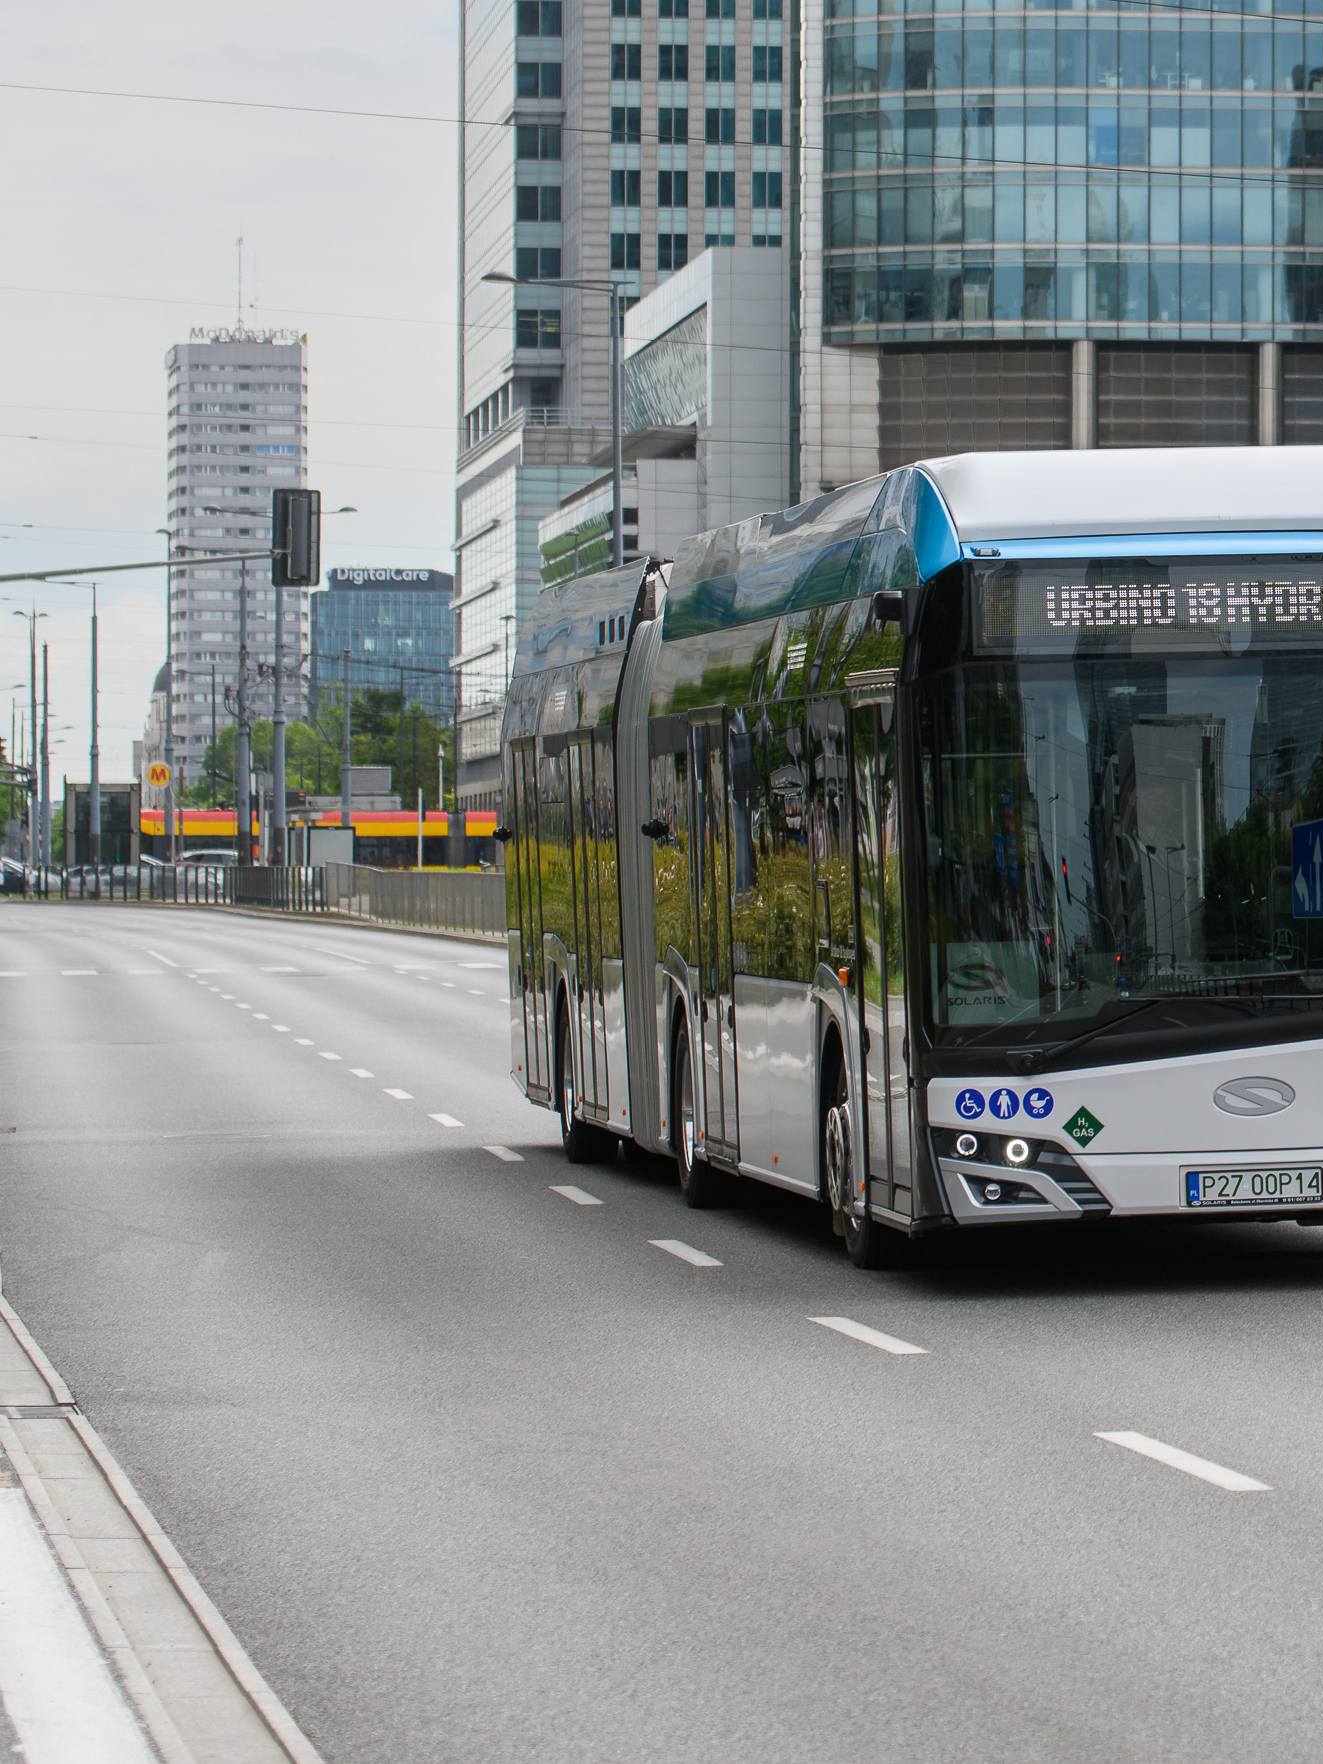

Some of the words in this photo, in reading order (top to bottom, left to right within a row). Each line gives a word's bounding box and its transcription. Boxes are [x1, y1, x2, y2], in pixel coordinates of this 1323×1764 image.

[337, 567, 429, 585] DigitalCare
[1047, 584, 1175, 626] URBINO
[1181, 583, 1221, 623] 18
[151, 768, 167, 783] M
[947, 996, 1006, 1007] SOLARIS
[1072, 1128, 1095, 1137] GAS
[1202, 1174, 1243, 1198] P27
[1251, 1171, 1320, 1195] 00P14
